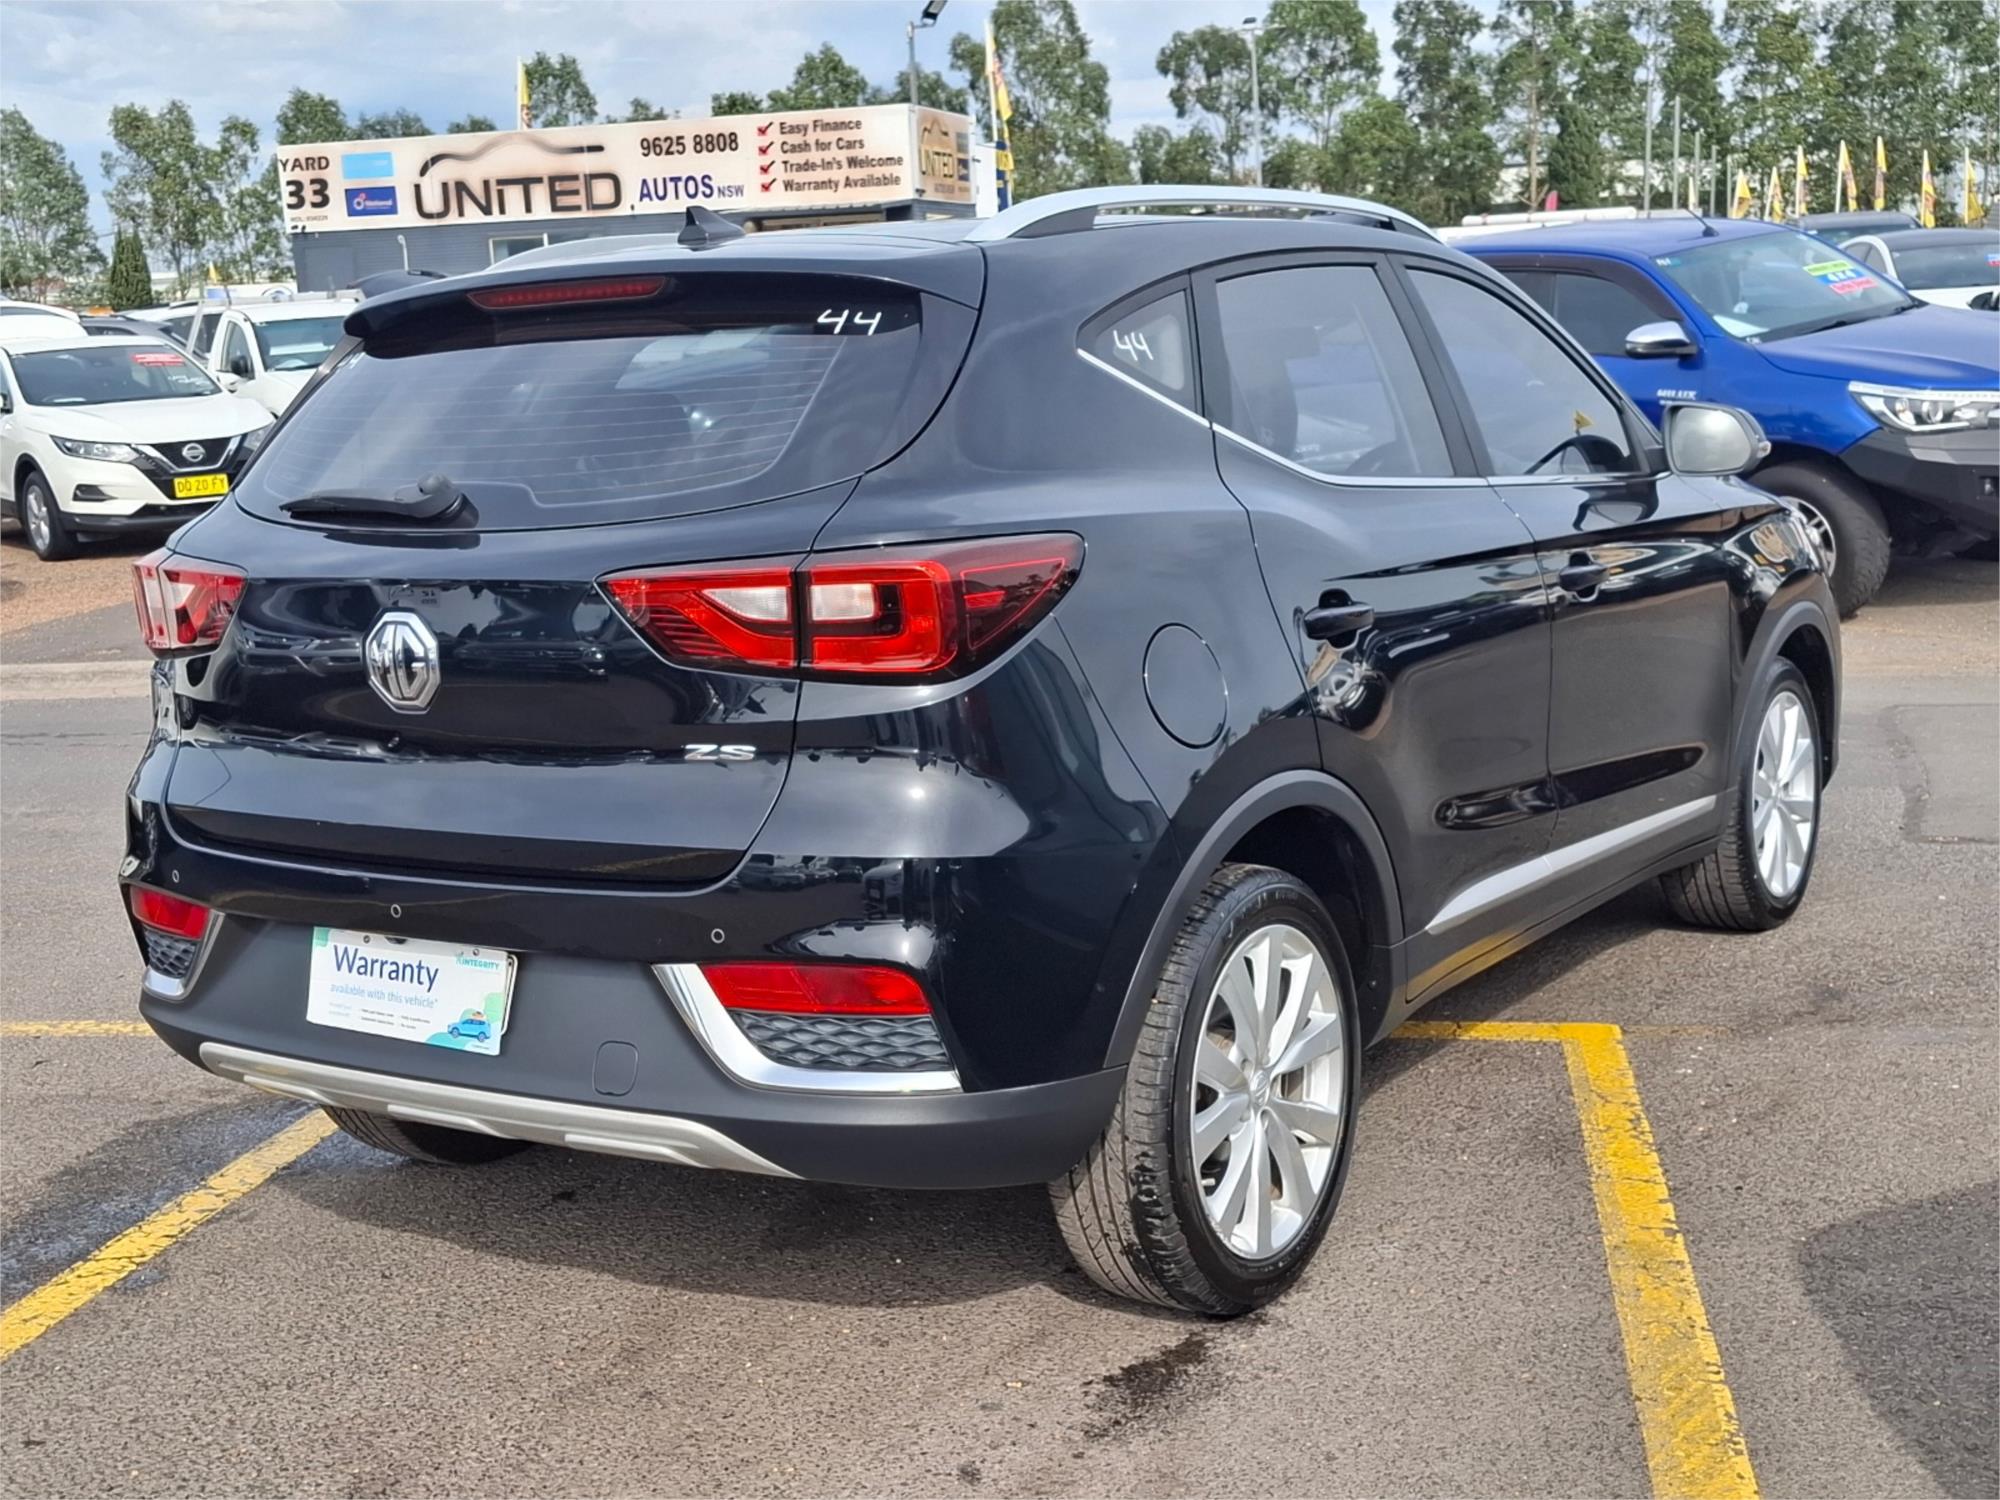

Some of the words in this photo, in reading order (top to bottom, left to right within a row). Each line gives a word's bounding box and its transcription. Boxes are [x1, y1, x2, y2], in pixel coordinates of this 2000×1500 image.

[779, 121, 809, 137] Easy
[812, 119, 862, 132] Finance
[640, 136, 686, 157] 9625
[693, 132, 739, 153] 8808
[780, 140, 812, 154] Cash
[815, 139, 832, 152] for
[836, 137, 865, 150] Cars
[279, 155, 331, 172] YARD
[781, 157, 844, 173] Trade-In's
[846, 155, 904, 169] Welcome
[285, 177, 331, 210] 33
[638, 174, 715, 202] AUTOS
[717, 184, 745, 198] NSW
[782, 178, 840, 193] Warranty
[843, 173, 902, 189] Available
[413, 172, 622, 220] UNITED
[816, 309, 883, 336] 44
[1112, 329, 1154, 361] 44
[369, 622, 430, 701] MG
[684, 743, 757, 761] ZS
[333, 944, 440, 993] Warranty
[330, 983, 366, 998] available
[367, 989, 386, 1001] with
[387, 991, 403, 1004] this
